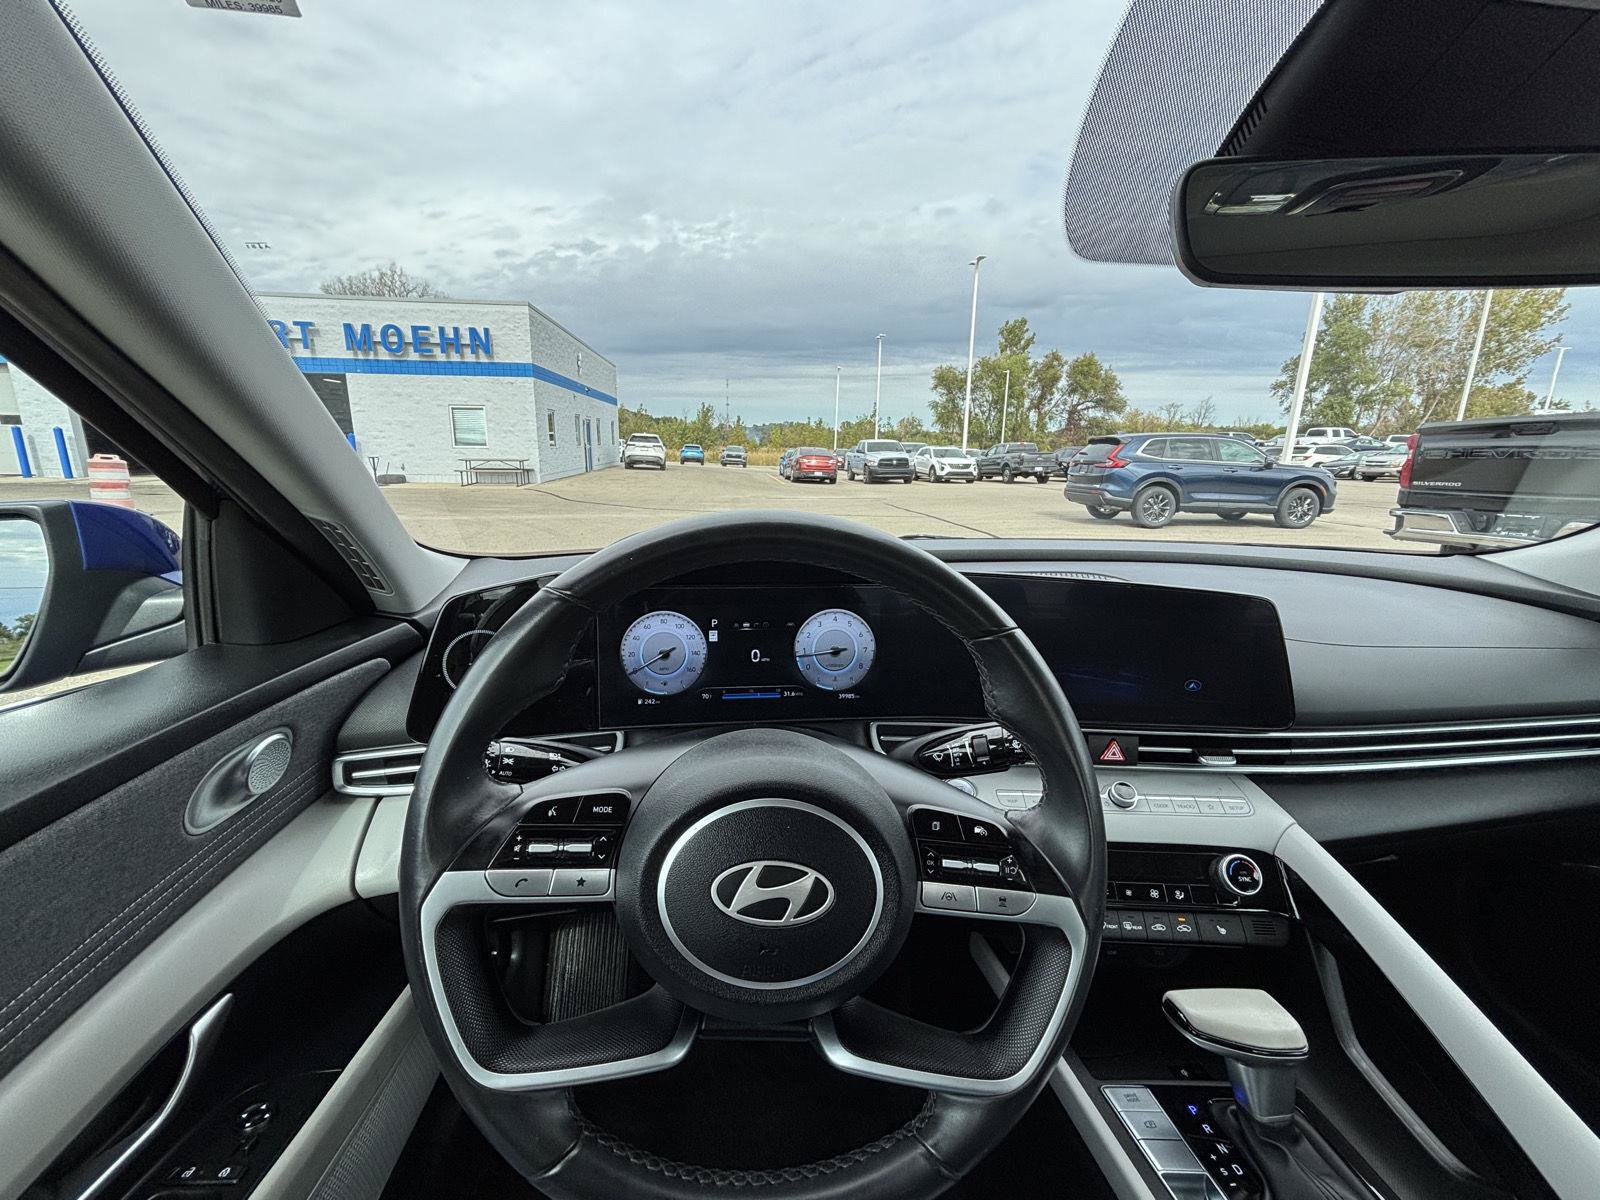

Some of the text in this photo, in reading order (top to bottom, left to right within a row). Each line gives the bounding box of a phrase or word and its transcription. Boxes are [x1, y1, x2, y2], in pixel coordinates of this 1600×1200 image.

[247, 2, 283, 14] 39985
[343, 322, 493, 356] MOEHN
[711, 618, 719, 628] P
[751, 649, 761, 662] 0
[592, 806, 613, 814] MODE
[1237, 875, 1252, 883] SYNC
[1188, 1105, 1197, 1115] P
[1202, 1123, 1214, 1134] R
[1216, 1143, 1229, 1154] N
[1220, 1167, 1229, 1176] S
[1232, 1164, 1244, 1176] D
